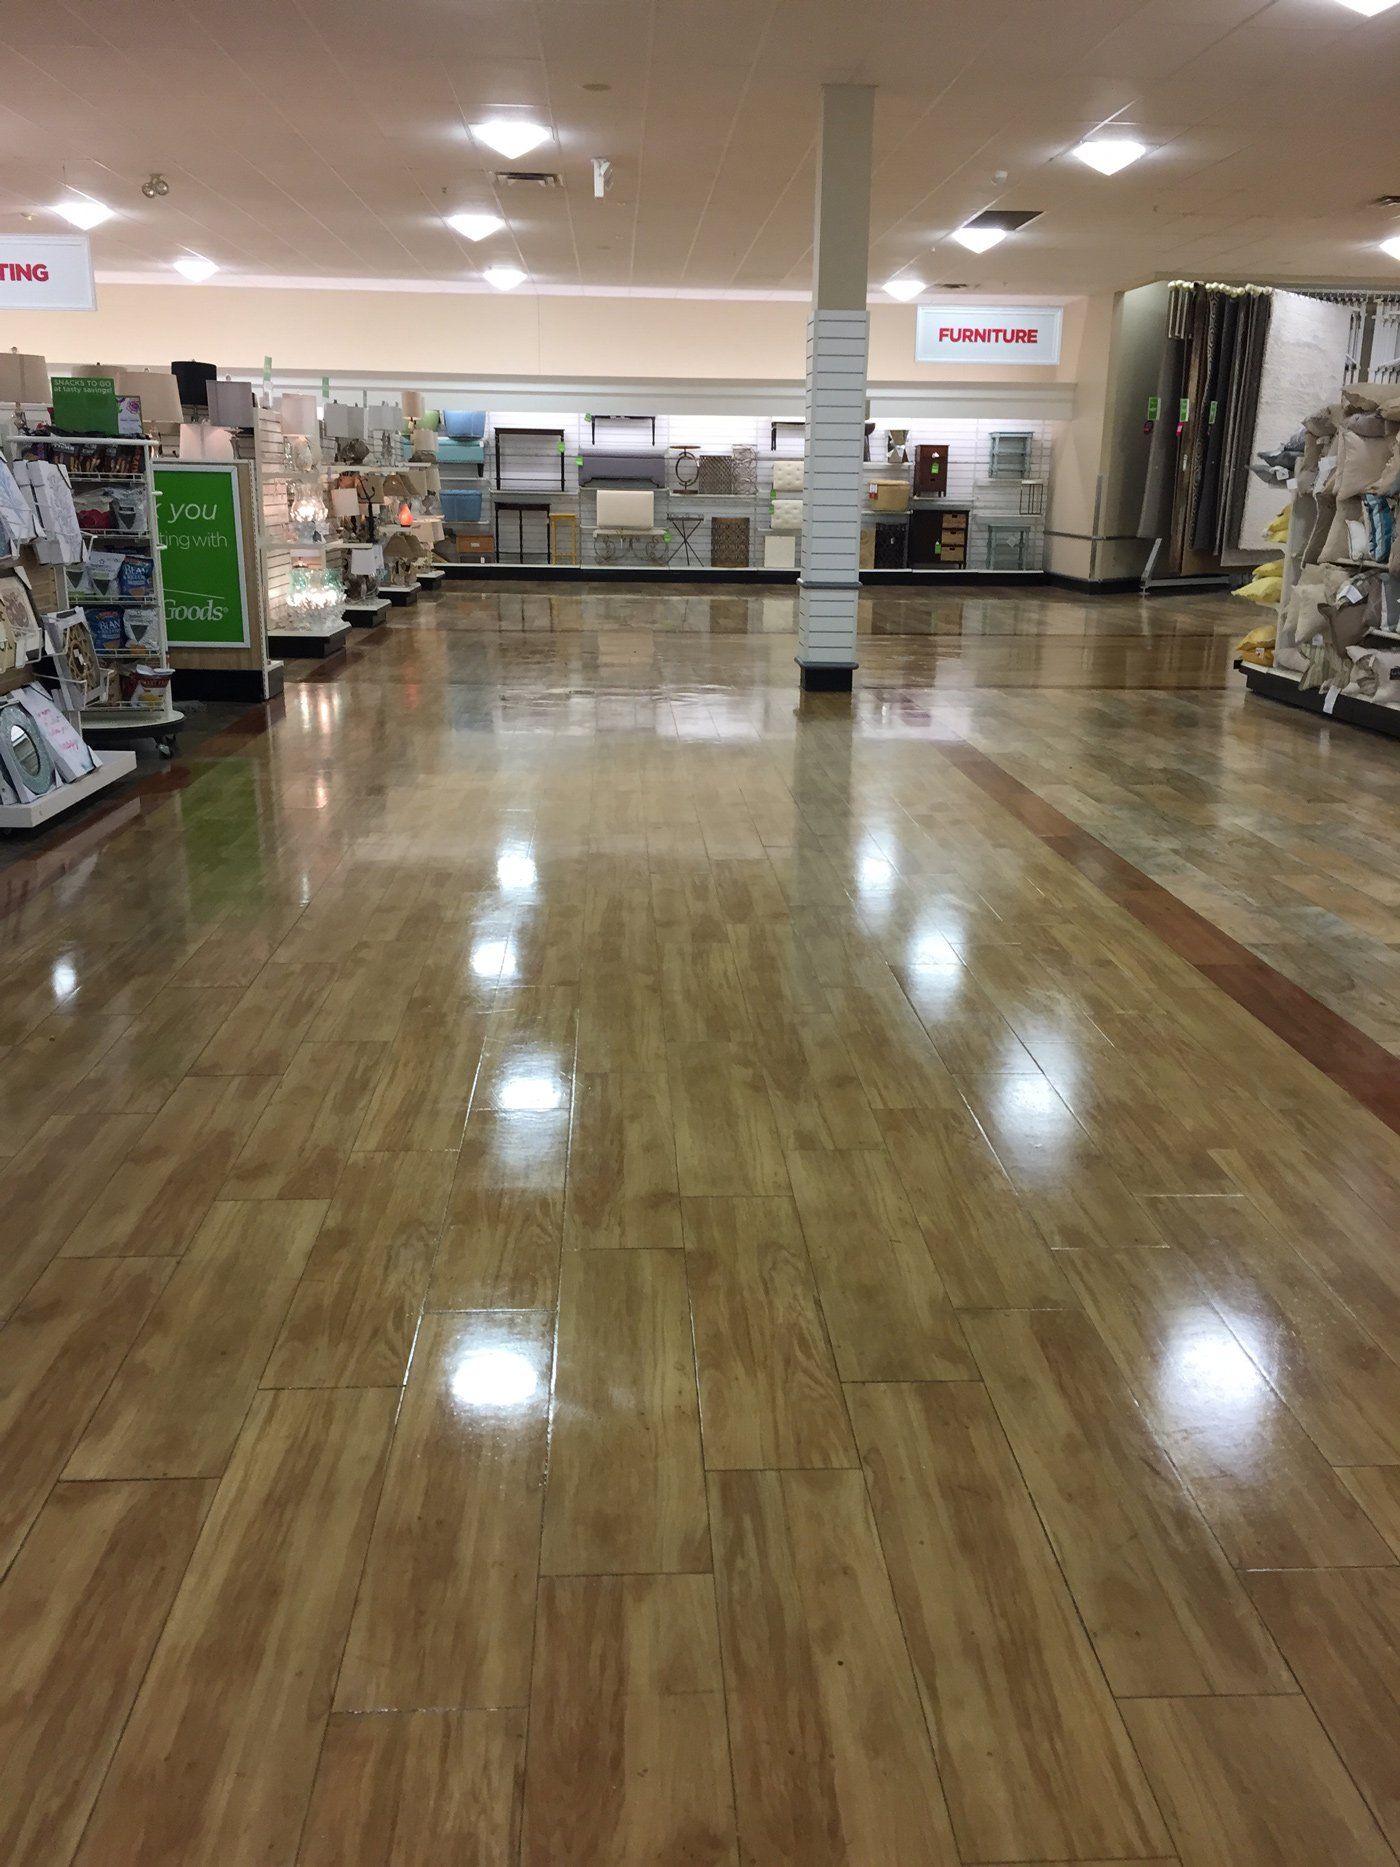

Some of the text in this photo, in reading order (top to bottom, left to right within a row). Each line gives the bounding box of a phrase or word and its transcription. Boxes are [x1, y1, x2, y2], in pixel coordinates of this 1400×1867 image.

[939, 327, 1038, 344] FURNITURE
[54, 379, 85, 387] SNACKS
[167, 503, 218, 523] you
[191, 530, 228, 548] with
